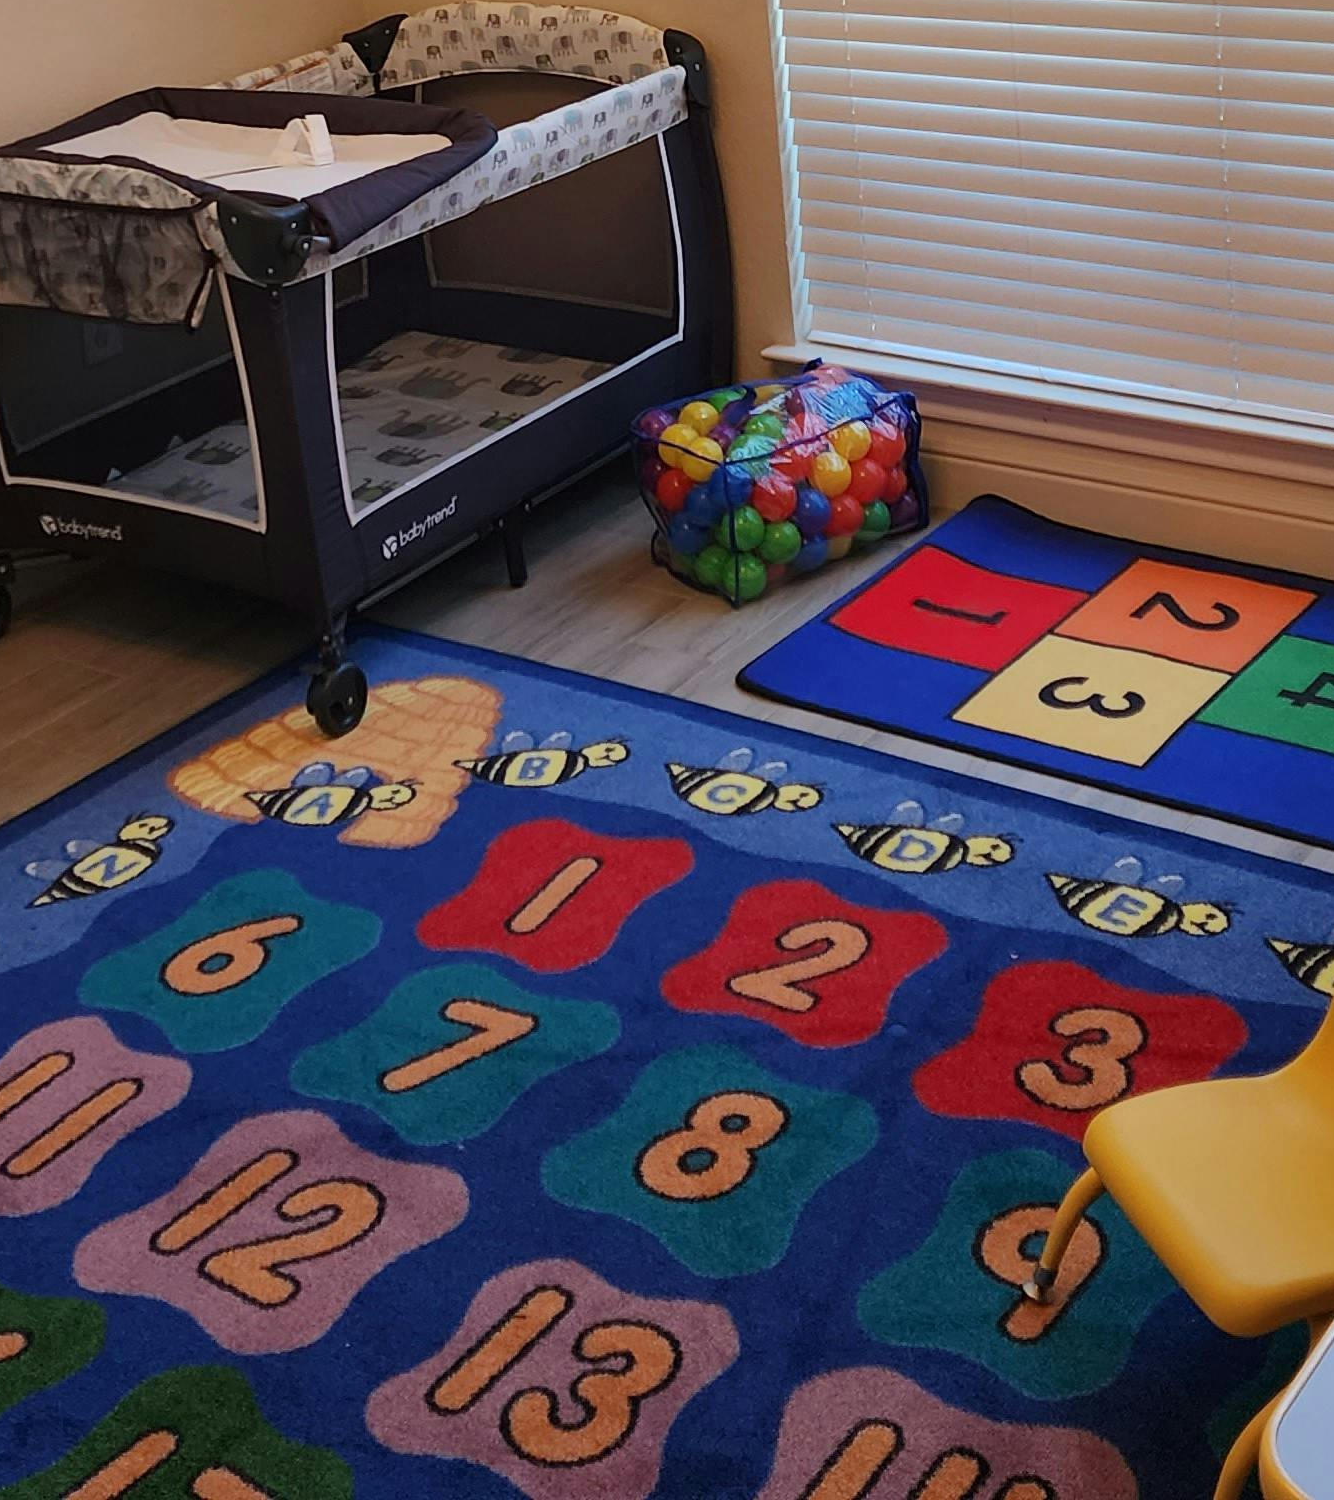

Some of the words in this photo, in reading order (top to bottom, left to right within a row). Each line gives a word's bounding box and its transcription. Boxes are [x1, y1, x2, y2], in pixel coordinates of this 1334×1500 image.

[398, 494, 458, 547] babytrend
[913, 599, 1010, 626] 1
[1129, 590, 1239, 632] 2
[1038, 675, 1146, 720] 3
[518, 756, 544, 782] B
[715, 783, 749, 807] C
[291, 794, 330, 819] A
[97, 846, 140, 882] Z
[896, 835, 937, 864] D
[505, 857, 603, 935] 1
[1104, 893, 1152, 928] E
[160, 914, 304, 996] 6
[727, 917, 873, 1013] 2
[381, 998, 539, 1093] 7
[1014, 1007, 1148, 1111] 3
[634, 1089, 790, 1199] 8
[148, 1148, 387, 1308] 12
[973, 1203, 1107, 1342] 9
[424, 1285, 683, 1468] 13
